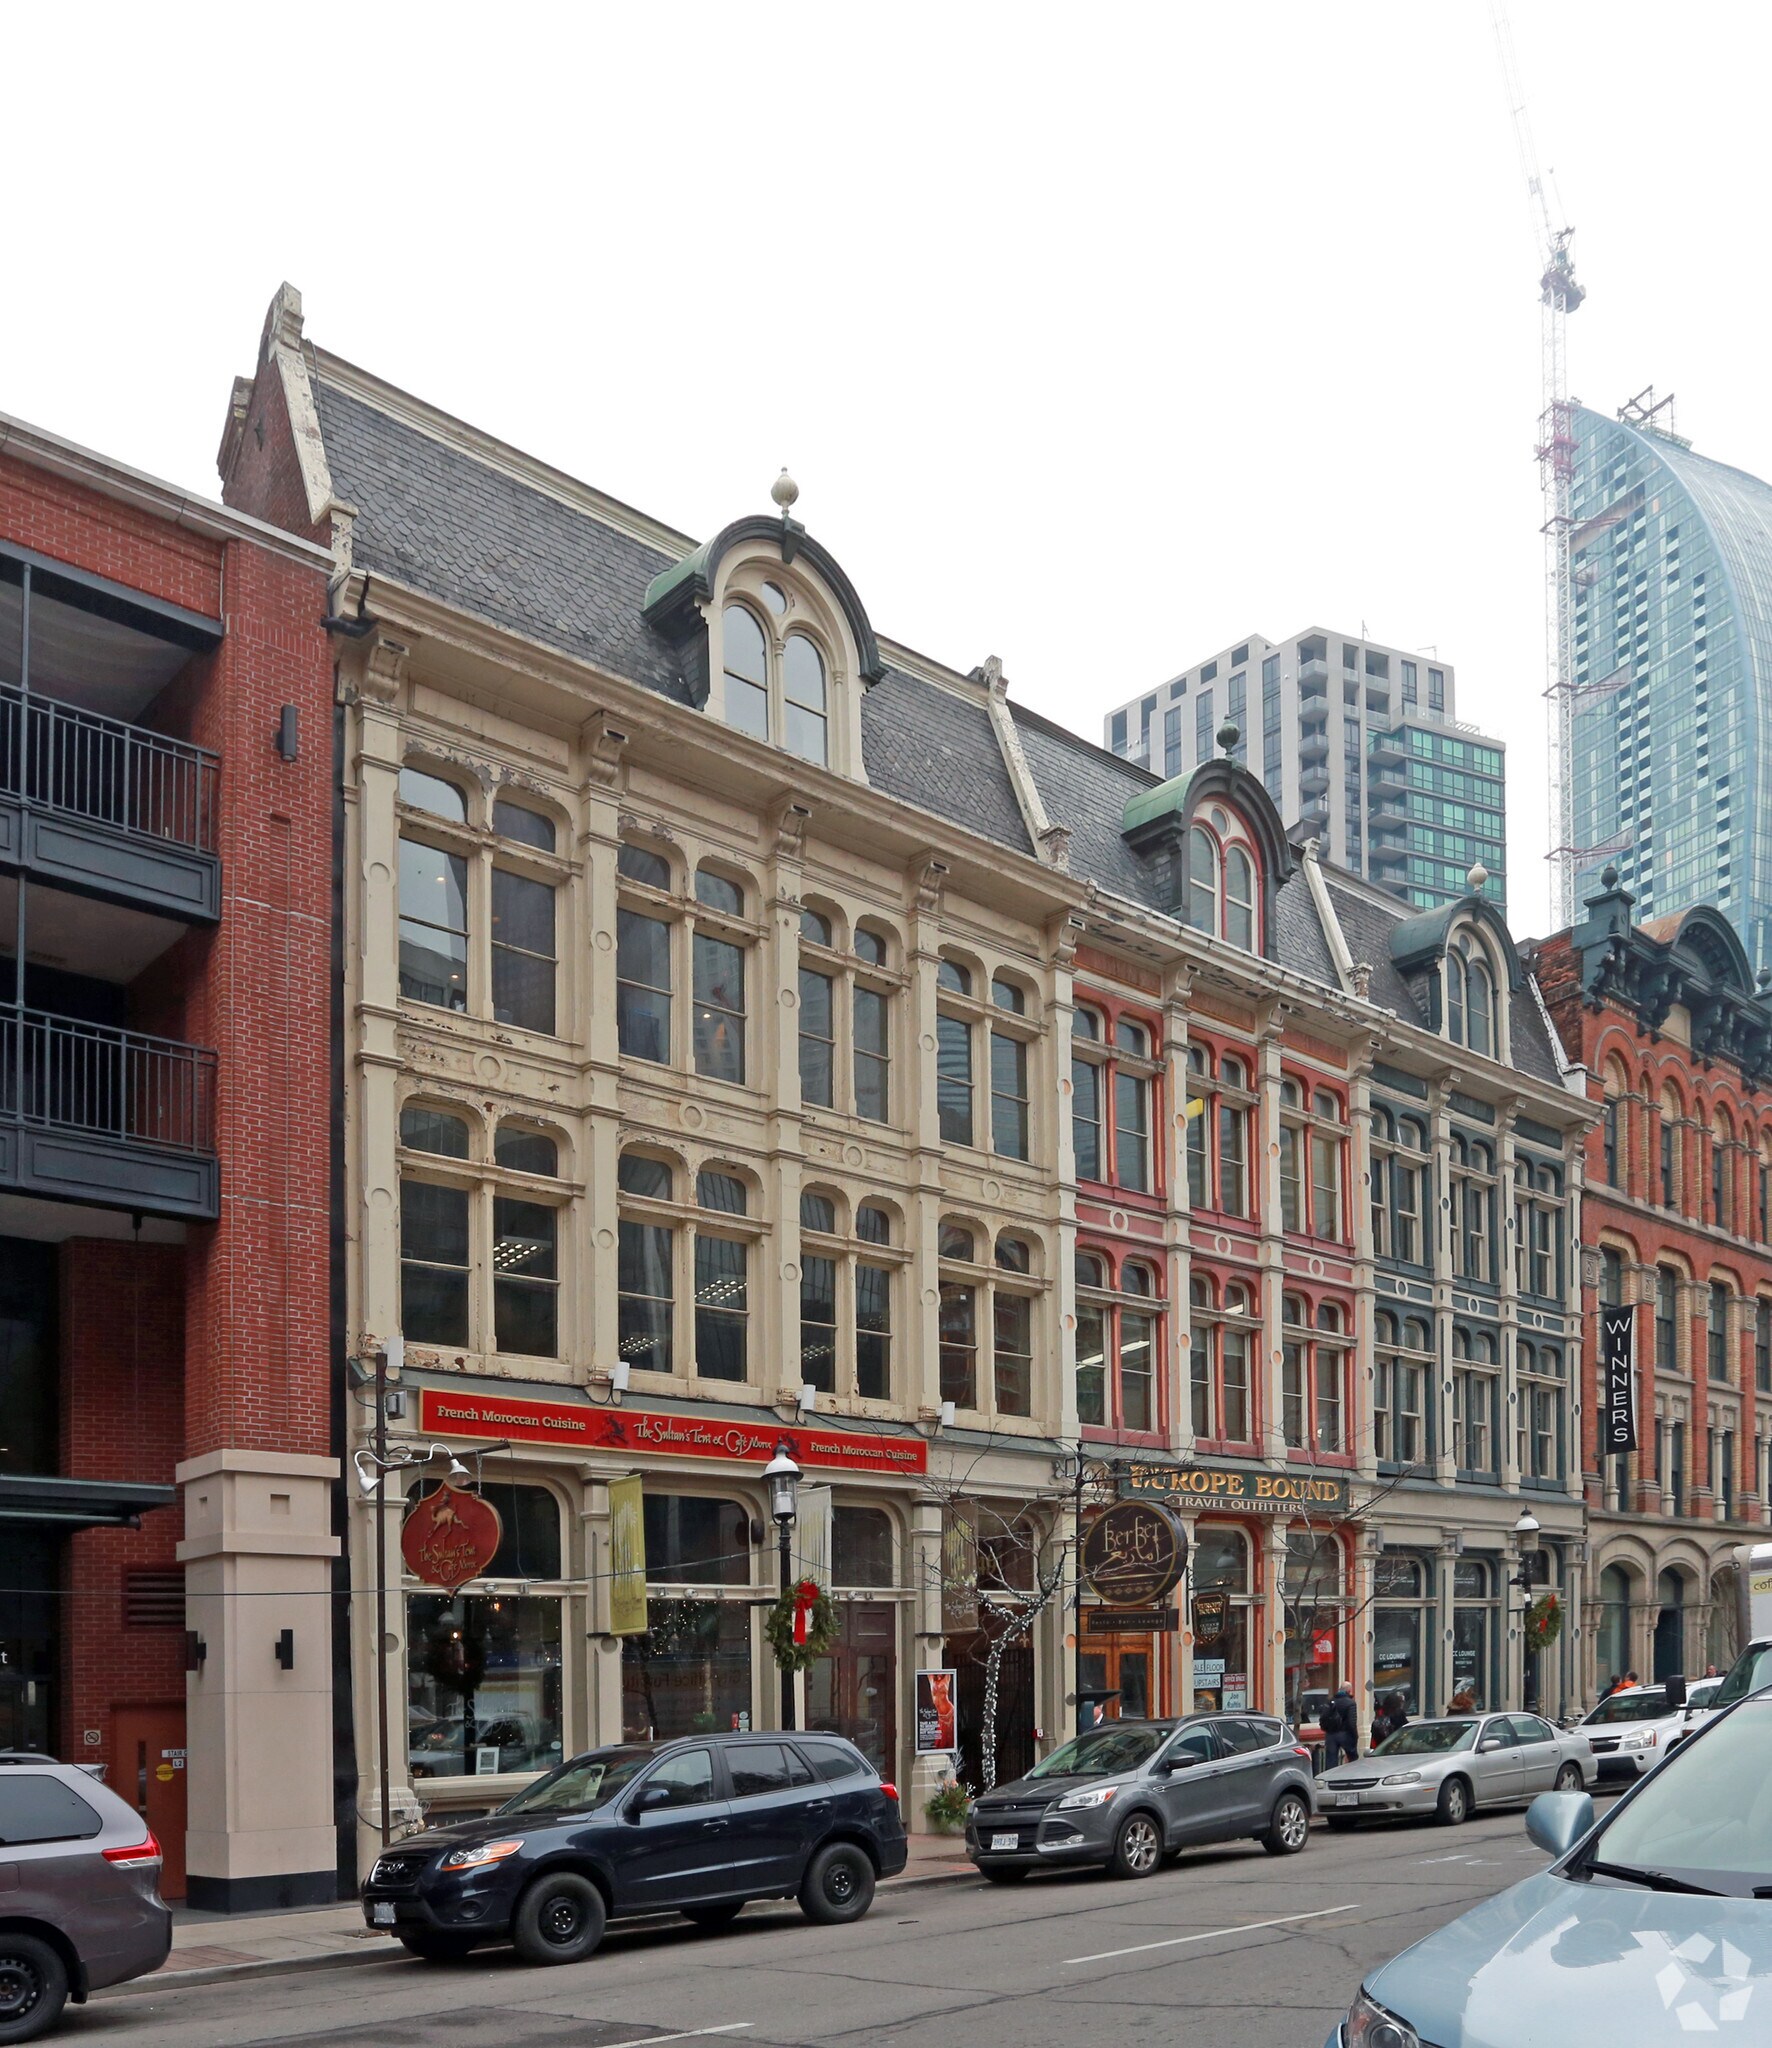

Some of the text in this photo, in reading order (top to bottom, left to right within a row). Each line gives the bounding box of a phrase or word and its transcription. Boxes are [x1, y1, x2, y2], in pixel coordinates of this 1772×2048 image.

[1606, 1317, 1630, 1442] WINNERS
[437, 1405, 586, 1430] French Moroccan Cuisine
[633, 1416, 652, 1438] The
[653, 1419, 690, 1443] Sultan's
[690, 1426, 711, 1443] Tent
[811, 1442, 917, 1460] French Moroccan Cuisine
[1130, 1464, 1245, 1496] EUROPE
[1255, 1476, 1340, 1502] BOUND
[1177, 1496, 1305, 1513] TRAVEL OUTFITTERS
[418, 1540, 432, 1562] The
[1753, 1577, 1772, 1591] cof
[1194, 1679, 1220, 1687] UPSTAIRS
